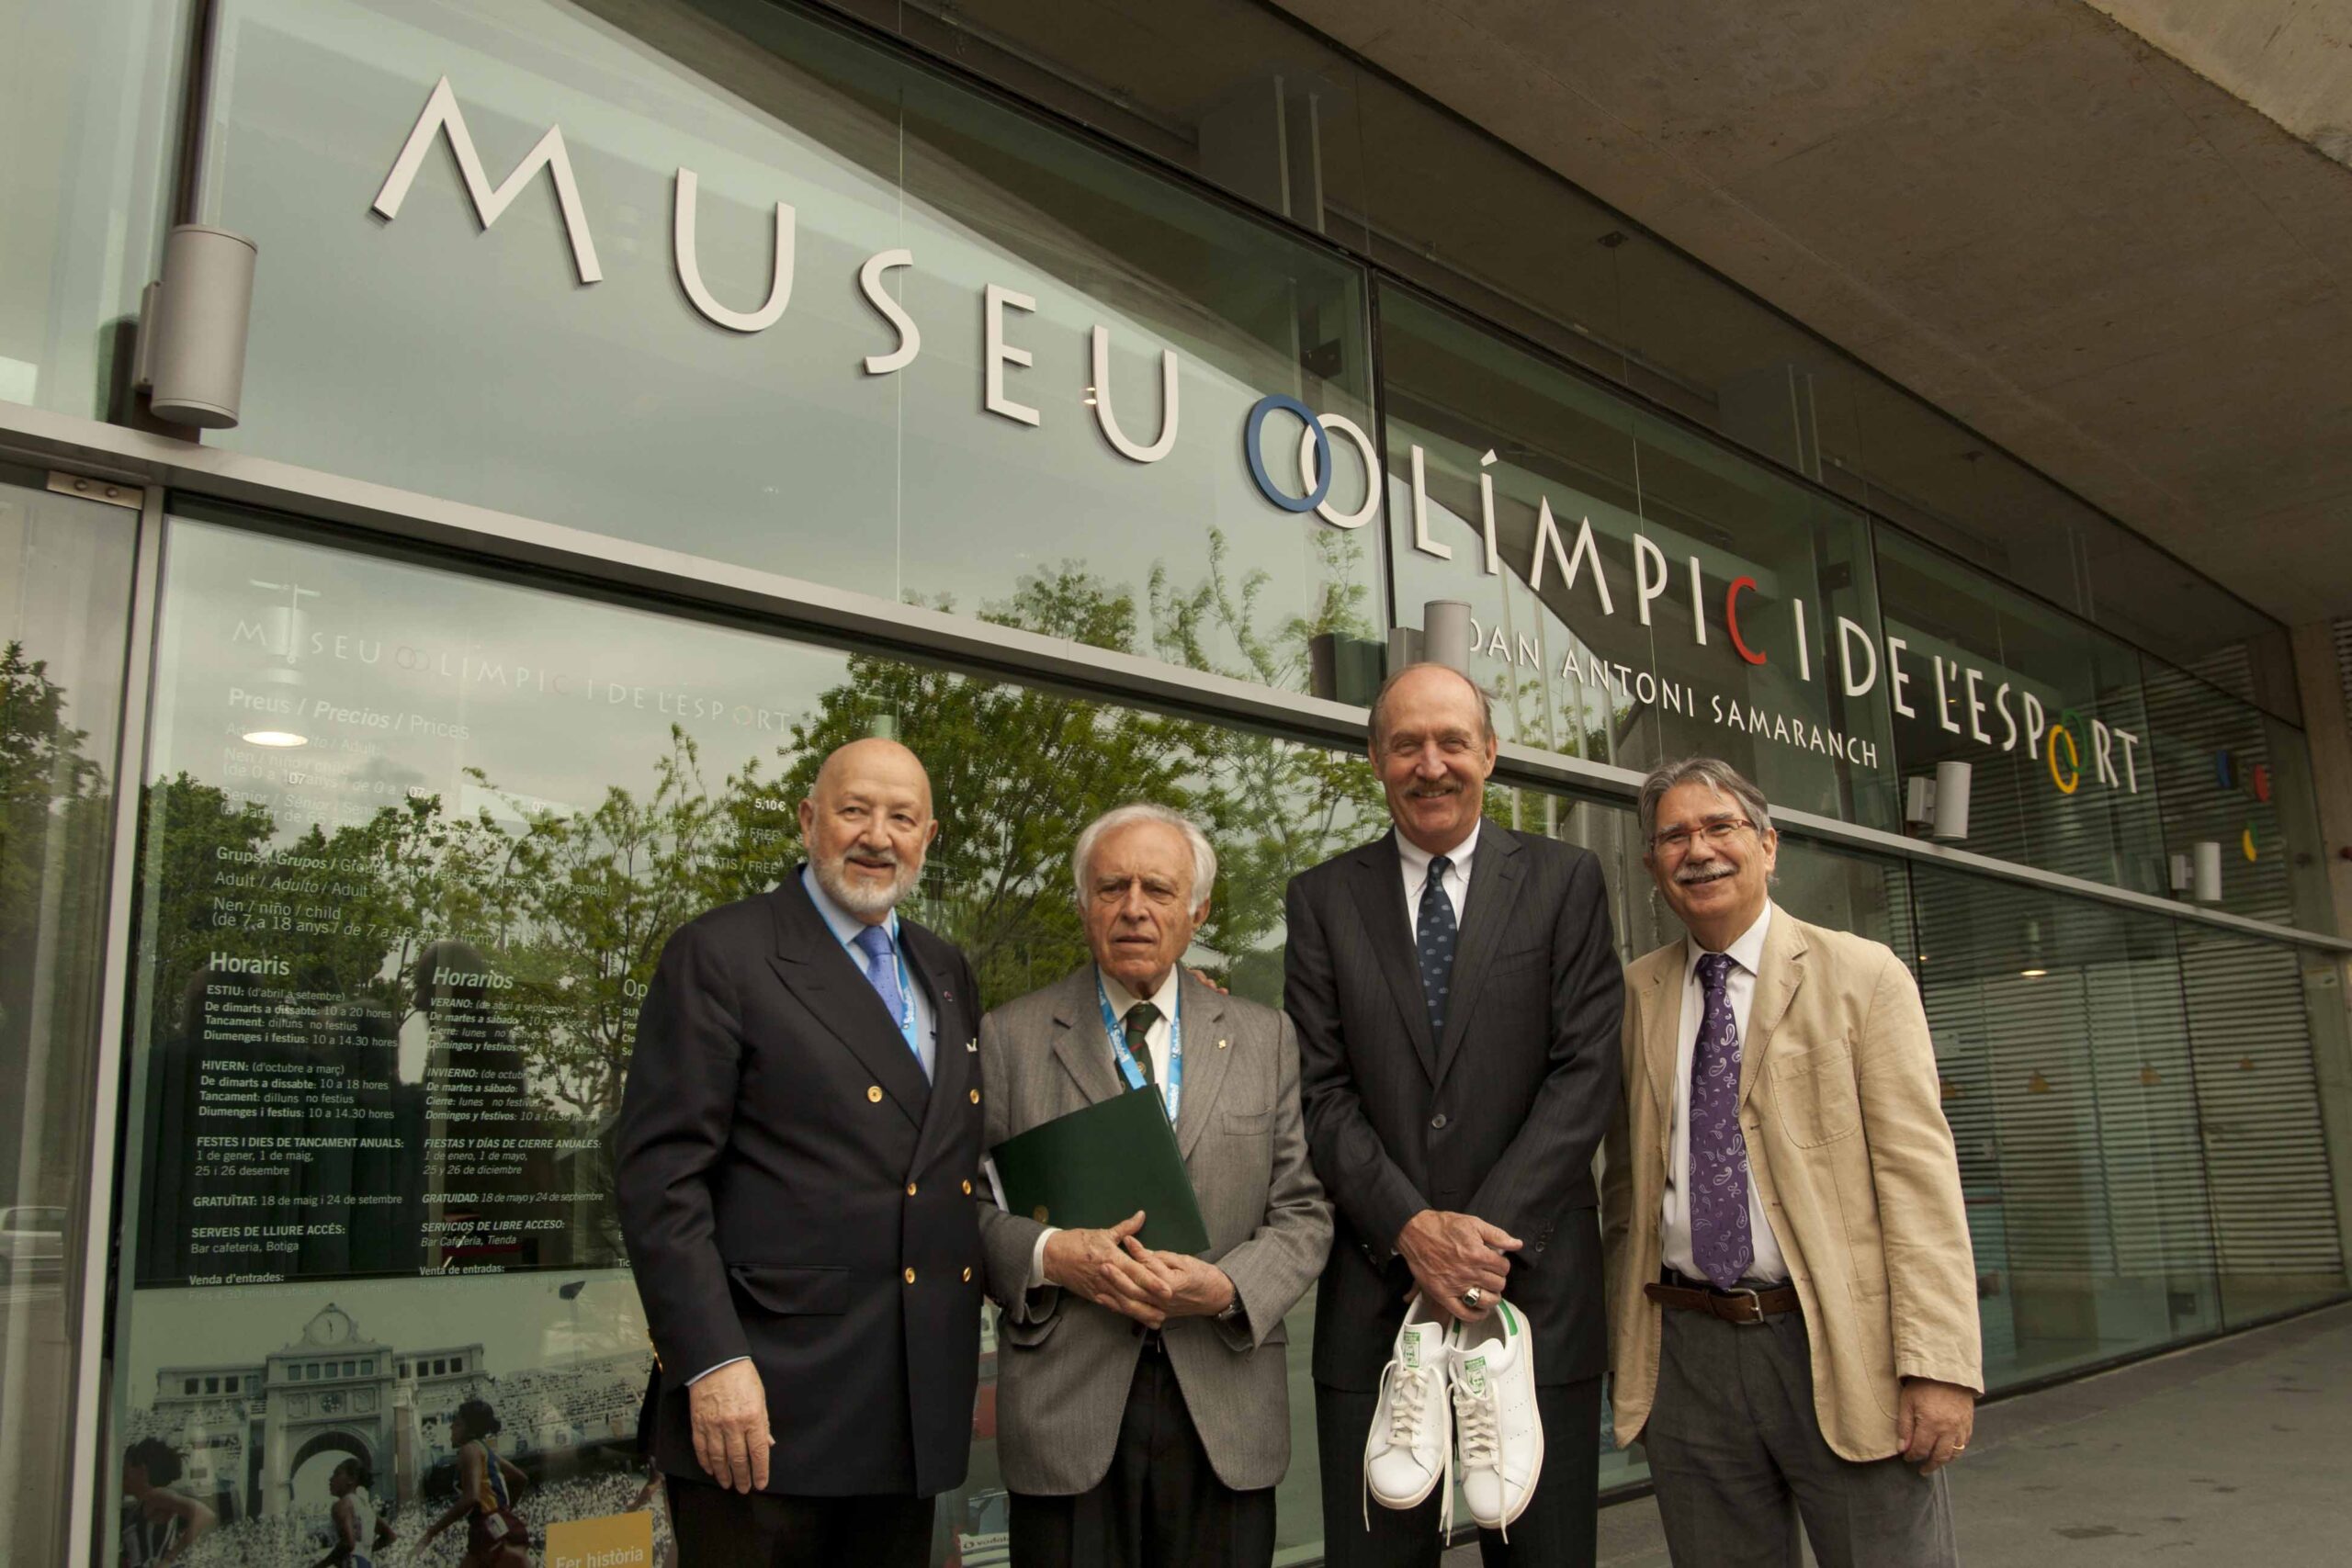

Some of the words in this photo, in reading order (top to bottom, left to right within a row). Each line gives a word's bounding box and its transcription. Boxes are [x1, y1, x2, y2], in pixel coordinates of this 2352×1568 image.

[369, 74, 1180, 466] MUSEU
[1838, 615, 1916, 720] DE
[228, 687, 291, 714] Preus
[314, 700, 390, 728] Precios
[411, 714, 470, 740] Prices
[1563, 648, 1695, 718] ANTONI
[1712, 694, 1878, 771] SAMARANCH
[277, 852, 327, 871] Grupos
[215, 871, 255, 887] Adult
[270, 876, 319, 893] Adulto
[214, 897, 243, 912] Nen
[259, 901, 291, 917] niño
[306, 906, 342, 919] child
[213, 912, 237, 926] (de
[272, 916, 292, 931] 18
[344, 922, 362, 936] de
[209, 951, 291, 976] Horaris
[431, 966, 514, 990] Horarios
[207, 985, 244, 997] ESTIU:
[248, 987, 284, 998] (d'abril
[296, 991, 345, 1003] setembre)
[205, 1001, 220, 1012] De
[222, 1002, 262, 1014] dimarts
[275, 1003, 321, 1016] dissabte:
[323, 1006, 338, 1016] 10
[350, 1007, 364, 1018] 20
[366, 1009, 393, 1019] hores
[430, 998, 474, 1009] VERANO:
[476, 999, 491, 1010] (de
[493, 1001, 514, 1011] abril
[204, 1015, 266, 1028] Tancament:
[268, 1017, 303, 1029] dilluns
[310, 1021, 322, 1030] no
[325, 1020, 359, 1031] festius
[429, 1011, 442, 1021] De
[445, 1013, 476, 1023] martes
[203, 1030, 263, 1043] Diumenges
[272, 1032, 310, 1043] festius:
[312, 1034, 326, 1044] 10
[339, 1035, 369, 1046] 14.30
[372, 1036, 399, 1047] hores
[429, 1026, 458, 1036] Cierre:
[461, 1028, 487, 1038] lunes
[493, 1030, 506, 1038] no
[428, 1040, 473, 1052] Domingos
[482, 1041, 518, 1052] festivos:
[201, 1060, 249, 1072] HIVERN:
[252, 1062, 304, 1075] (d'octubre
[316, 1064, 345, 1077] març)
[427, 1067, 479, 1079] INVIERNO:
[481, 1069, 496, 1080] (de
[200, 1076, 216, 1086] De
[219, 1076, 259, 1088] dimarts
[271, 1077, 317, 1089] dissabte:
[320, 1078, 334, 1089] 10
[346, 1079, 360, 1090] 18
[362, 1080, 390, 1091] hores
[426, 1082, 440, 1093] De
[442, 1083, 473, 1093] martes
[483, 1082, 518, 1094] sábado:
[199, 1090, 261, 1102] Tancament:
[264, 1092, 300, 1103] dilluns
[306, 1095, 319, 1103] no
[322, 1093, 356, 1104] festius
[426, 1096, 456, 1106] Cierre:
[458, 1097, 484, 1107] lunes
[492, 1099, 503, 1108] no
[198, 1105, 257, 1119] Diumenges
[267, 1107, 305, 1118] festius:
[309, 1108, 322, 1119] 10
[335, 1108, 367, 1120] 14.30
[368, 1109, 395, 1120] hores
[425, 1111, 470, 1122] Domingos
[481, 1111, 517, 1122] festivos:
[521, 1111, 532, 1121] 10
[197, 1136, 239, 1147] FESTES
[248, 1136, 274, 1147] DIES
[277, 1137, 292, 1147] DE
[295, 1137, 357, 1148] TANCAMENT
[359, 1137, 404, 1148] ANUALS:
[424, 1138, 466, 1148] FIESTAS
[478, 1136, 500, 1148] DÍAS
[503, 1138, 516, 1148] DE
[517, 1138, 553, 1148] CIERRE
[555, 1138, 603, 1149] ANUALES:
[207, 1150, 221, 1161] de
[223, 1152, 255, 1163] gener,
[269, 1150, 283, 1161] de
[286, 1151, 314, 1163] maig,
[434, 1151, 446, 1160] de
[447, 1152, 476, 1163] enero,
[488, 1151, 500, 1161] de
[502, 1152, 528, 1163] mayo,
[195, 1165, 210, 1176] 25
[220, 1165, 236, 1177] 26
[239, 1166, 290, 1177] desembre
[423, 1165, 437, 1176] 25
[447, 1165, 461, 1176] 26
[463, 1166, 476, 1175] de
[477, 1164, 523, 1176] diciembre
[193, 1194, 258, 1207] GRATUÏTAT:
[261, 1195, 276, 1206] 18
[278, 1195, 290, 1206] de
[293, 1195, 318, 1207] maig
[326, 1194, 341, 1205] 24
[344, 1194, 356, 1205] de
[358, 1194, 403, 1205] setembre
[422, 1193, 479, 1204] GRATUIDAD:
[481, 1192, 493, 1202] 18
[494, 1193, 505, 1202] de
[506, 1194, 528, 1204] mayo
[535, 1192, 548, 1202] 24
[548, 1192, 559, 1202] de
[560, 1192, 605, 1203] septiembre
[191, 1226, 241, 1238] SERVEIS
[243, 1226, 260, 1236] DE
[263, 1225, 304, 1236] LLIURE
[306, 1223, 346, 1235] ACCÉS:
[421, 1221, 475, 1233] SERVICIOS
[477, 1221, 492, 1231] DE
[492, 1221, 523, 1231] LIBRE
[525, 1219, 566, 1230] ACCESO:
[190, 1243, 209, 1254] Bar
[212, 1242, 263, 1254] cafeteria,
[266, 1240, 300, 1253] Botiga
[421, 1236, 439, 1247] Bar
[487, 1235, 517, 1246] Tienda
[419, 1265, 447, 1276] Venta
[447, 1265, 460, 1275] de
[462, 1264, 505, 1275] entradas:
[189, 1274, 222, 1285] Venda
[225, 1271, 285, 1285] d'entrades:
[587, 1546, 645, 1568] història
